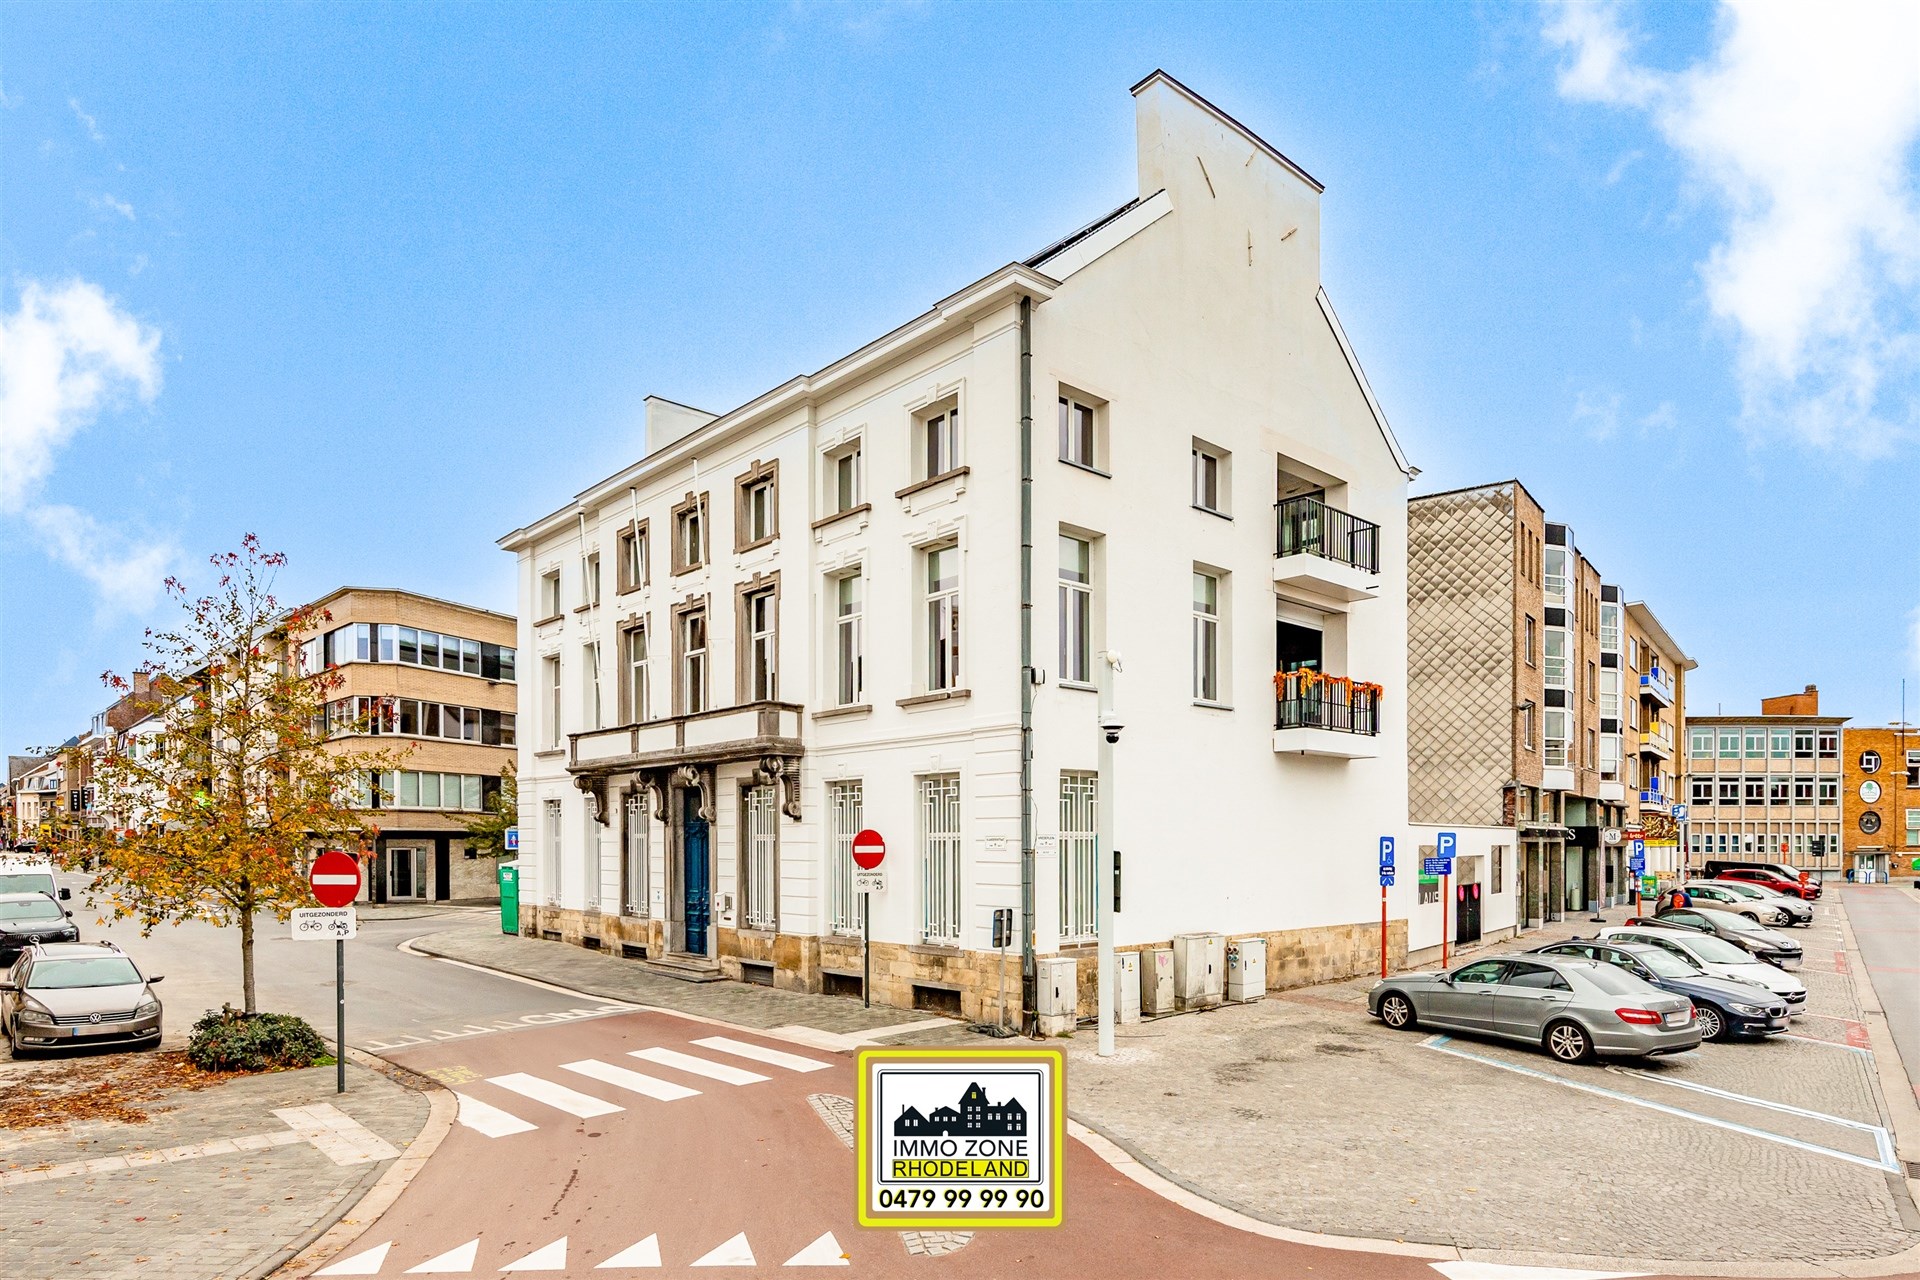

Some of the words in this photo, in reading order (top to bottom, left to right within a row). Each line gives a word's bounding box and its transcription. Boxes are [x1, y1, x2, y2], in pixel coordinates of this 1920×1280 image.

[1382, 840, 1393, 862] P
[1440, 836, 1454, 854] P
[1635, 842, 1644, 856] P
